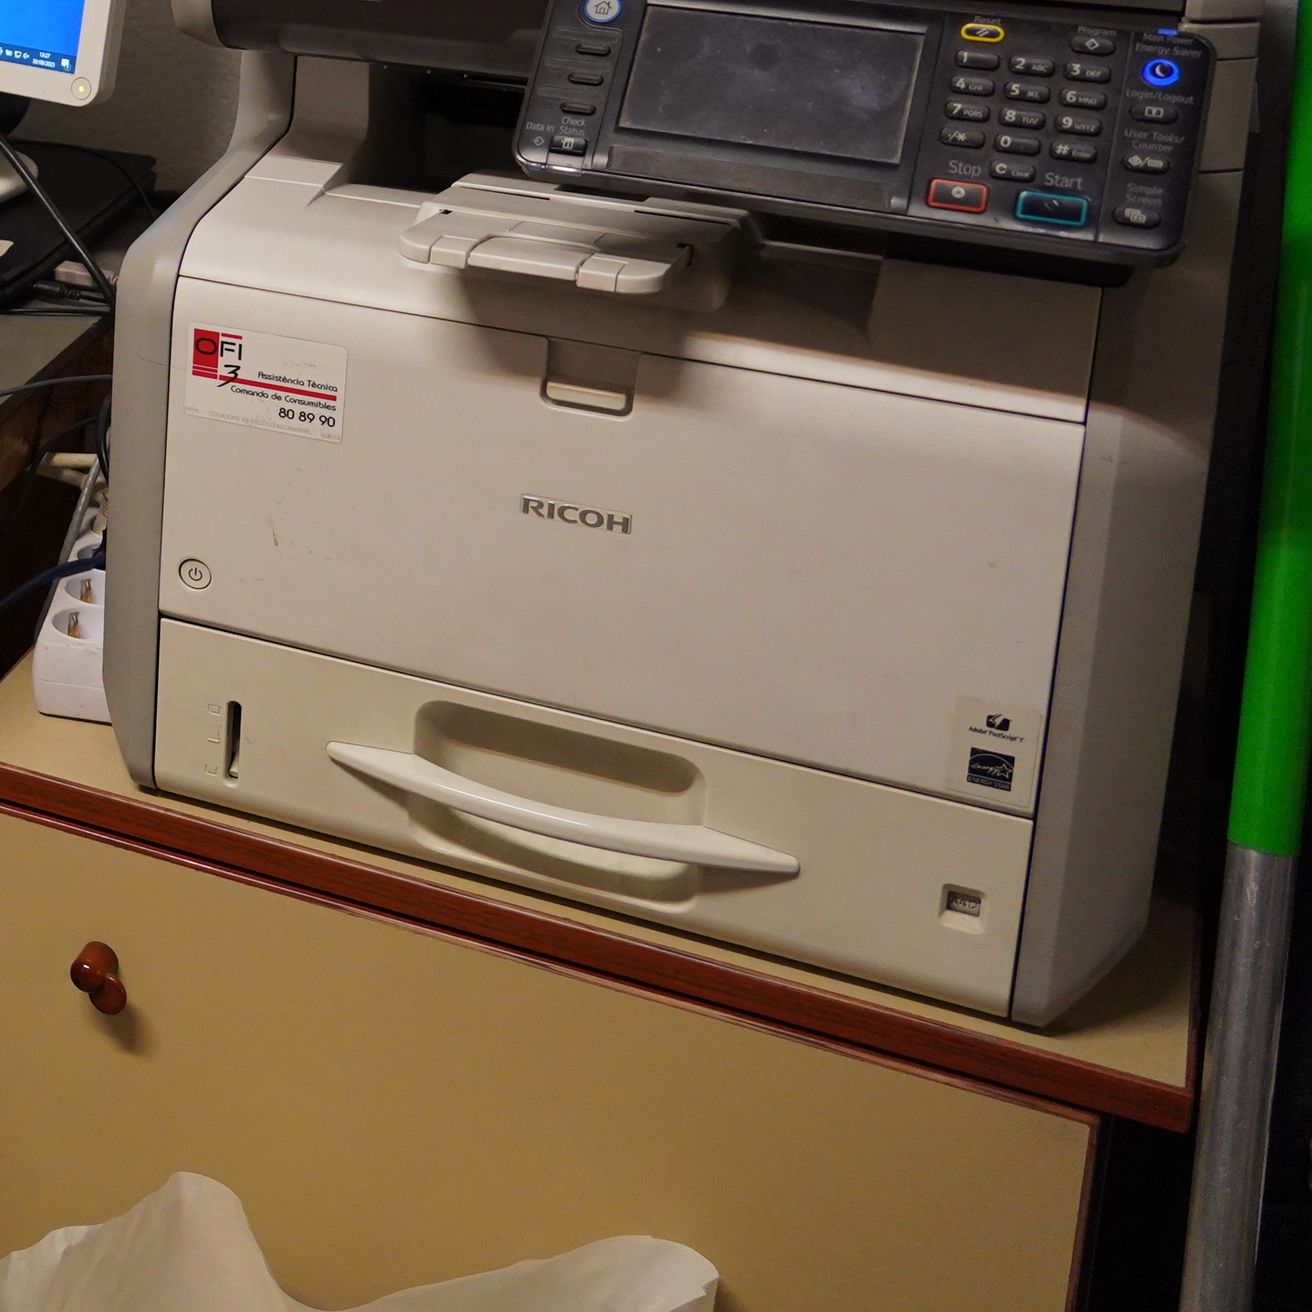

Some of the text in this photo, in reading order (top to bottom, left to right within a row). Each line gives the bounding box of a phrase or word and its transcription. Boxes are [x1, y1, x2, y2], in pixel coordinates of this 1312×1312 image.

[975, 16, 1002, 25] Reset
[1078, 26, 1117, 37] Program
[1135, 44, 1204, 57] Energy Saver
[962, 52, 968, 63] 1
[1015, 58, 1048, 72] 2 ABC
[1071, 63, 1081, 75] 3
[956, 78, 966, 89] 4
[1010, 83, 1020, 95] 5
[1066, 91, 1097, 105] 6 MNO
[1126, 90, 1194, 105] Login/Logout
[952, 103, 962, 114] 7
[561, 115, 586, 127] Check
[1005, 111, 1016, 122] 8
[526, 121, 544, 132] Data
[1062, 117, 1072, 129] 9
[559, 125, 586, 137] Status
[1124, 128, 1149, 140] User
[1000, 136, 1011, 147] 0
[1132, 140, 1174, 152] Counter
[948, 160, 981, 177] Stop
[995, 163, 1029, 177] C Clear
[1044, 173, 1082, 188] Start
[195, 338, 242, 361] OFI
[217, 364, 242, 388] 3
[230, 385, 337, 411] Comanda de Consumibles
[278, 407, 336, 428] 80 89 90
[521, 495, 630, 534] RICOH
